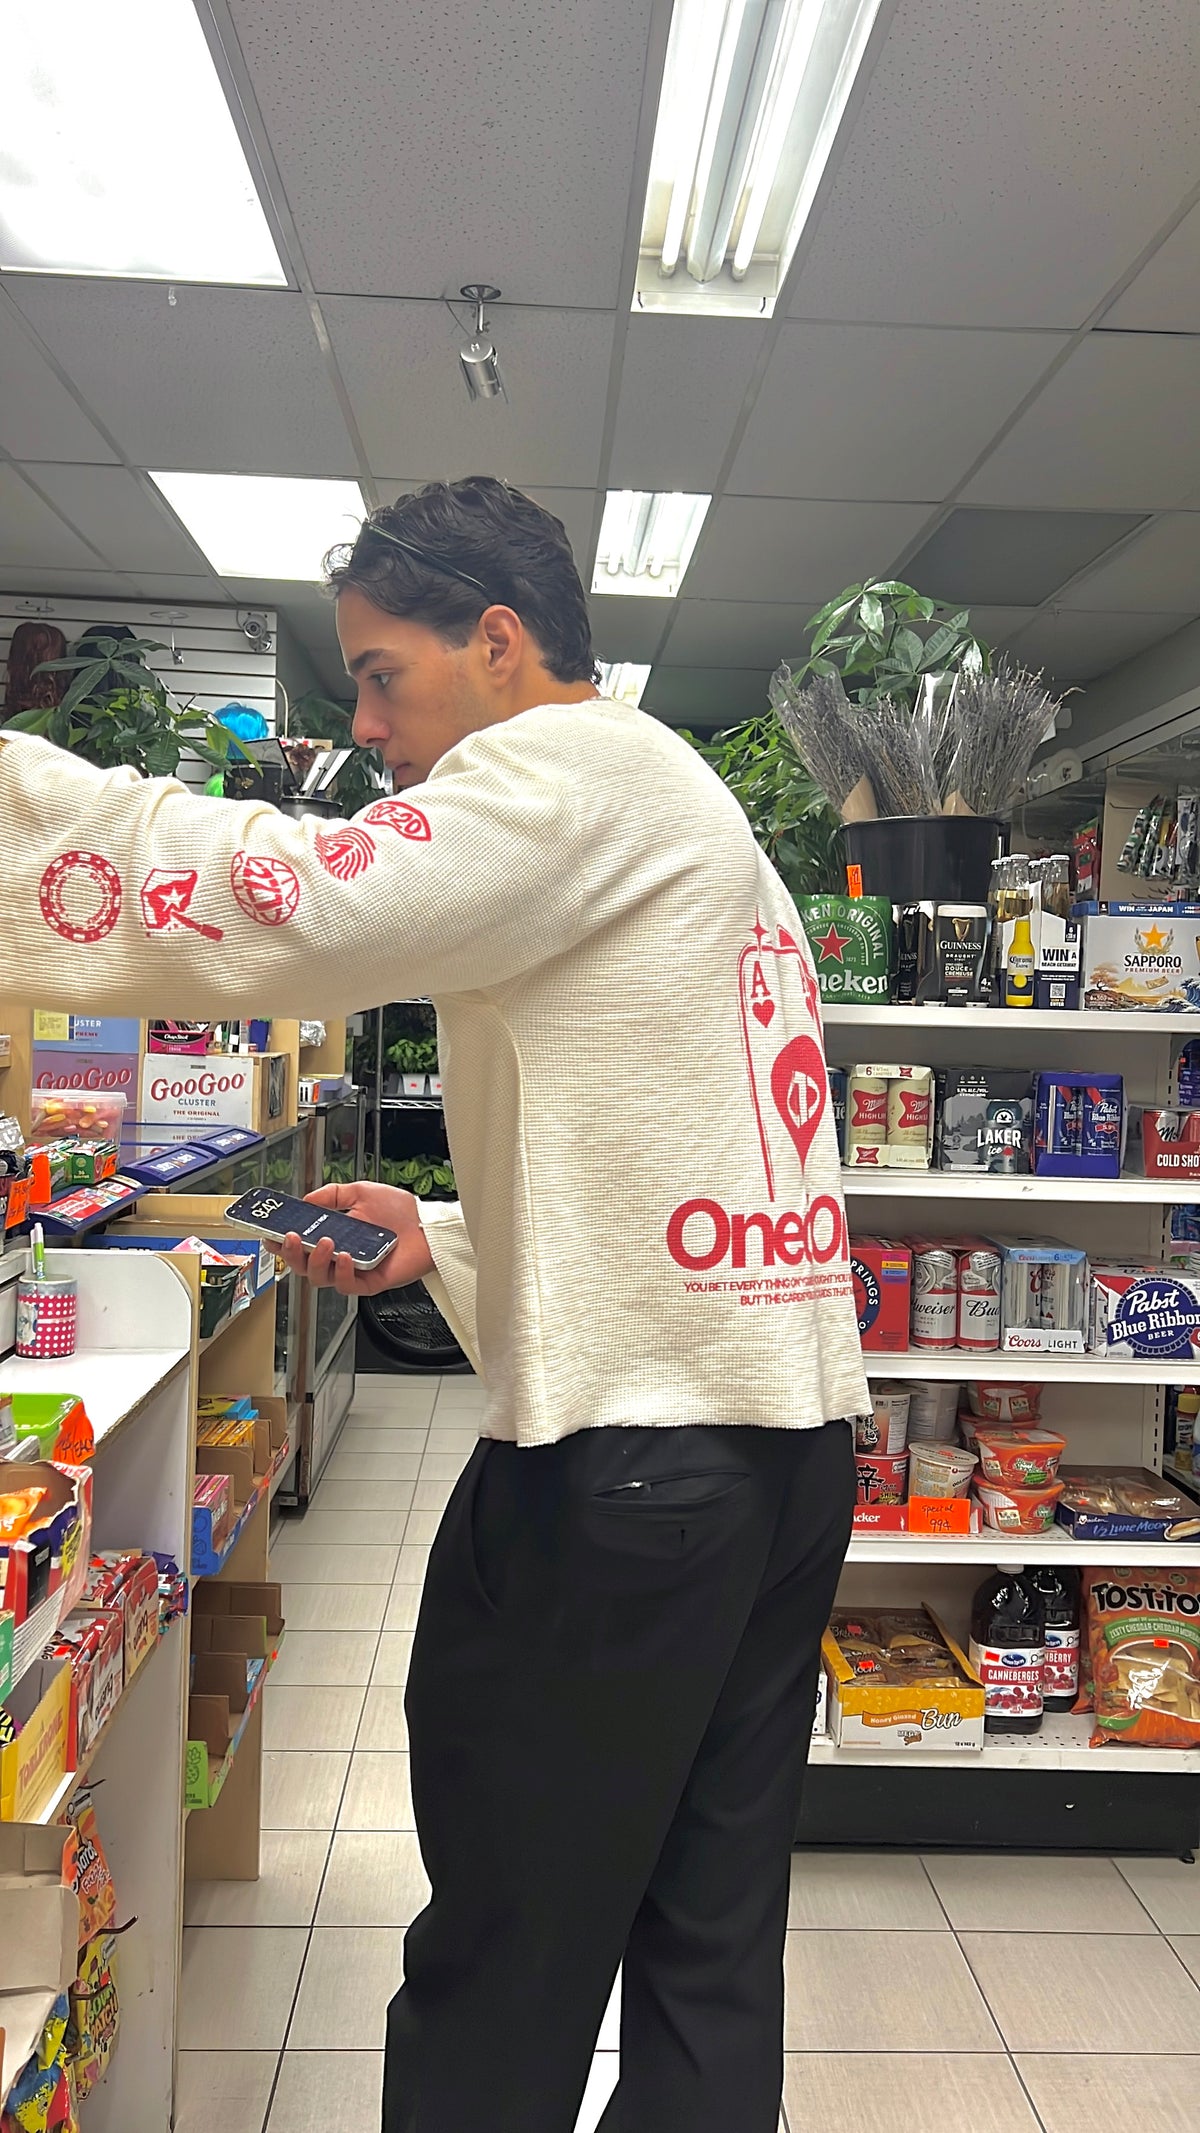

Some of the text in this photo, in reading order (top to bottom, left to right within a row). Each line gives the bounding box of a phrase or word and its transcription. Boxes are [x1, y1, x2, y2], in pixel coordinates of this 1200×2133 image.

[838, 904, 885, 960] ORIGINAL
[939, 940, 982, 950] GUINNESS
[1042, 948, 1070, 961] WIN
[1123, 954, 1182, 968] SAPPORO
[750, 961, 770, 999] A
[36, 1067, 133, 1090] GooGoo
[865, 1066, 872, 1076] 6
[150, 1073, 245, 1102] GooGoo
[177, 1098, 216, 1107] CLUSTER
[859, 1112, 877, 1120] HIGH
[976, 1128, 1022, 1149] LAKER
[987, 1145, 1003, 1155] ice
[1157, 1154, 1200, 1168] COLD SHO
[251, 1198, 284, 1219] 9:42
[684, 1281, 708, 1294] YOU
[708, 1281, 729, 1292] BET
[729, 1277, 791, 1292] EVERYTHING
[850, 1260, 879, 1306] PRINGS
[740, 1294, 762, 1307] BUT
[763, 1292, 782, 1305] THE
[1126, 1288, 1180, 1316] Pabst
[1110, 1319, 1147, 1341] Blue
[1147, 1330, 1175, 1341] BEER
[1008, 1334, 1078, 1350] Coors LIGHT
[856, 1463, 885, 1502] 辛
[1092, 1520, 1168, 1537] 1/2 Lune Moon
[987, 1669, 1040, 1681] CANNEBERGES
[870, 1715, 893, 1724] Honey
[920, 1708, 962, 1730] Bun
[90, 1996, 118, 2039] PATCH
